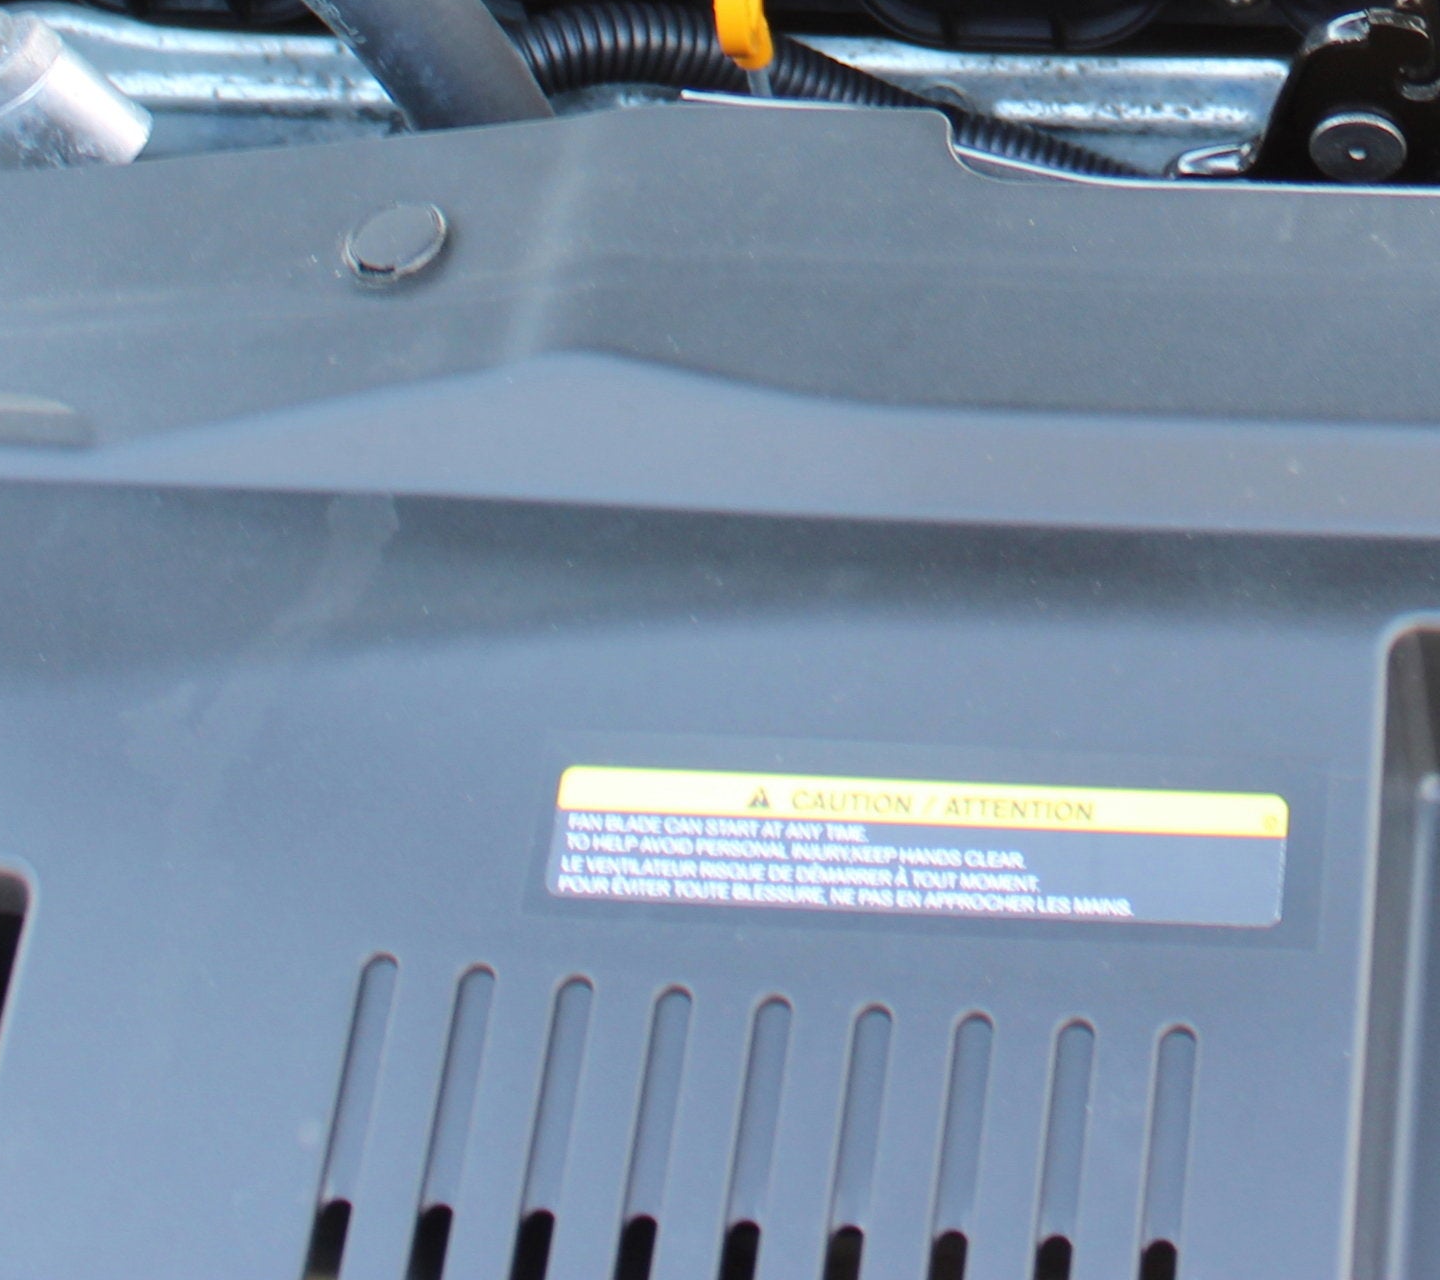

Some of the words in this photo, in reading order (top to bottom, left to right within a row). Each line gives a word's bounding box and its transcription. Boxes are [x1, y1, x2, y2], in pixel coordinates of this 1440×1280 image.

[791, 790, 912, 813] CAUTION
[945, 797, 1095, 822] ATTENTION
[568, 812, 604, 831] FAN
[606, 814, 663, 834] BLADE
[664, 816, 703, 836] CAN
[704, 818, 759, 838] START
[760, 821, 783, 838] AT
[785, 822, 824, 841] ANY
[566, 832, 590, 851] TO
[592, 834, 639, 853] HELP
[640, 836, 694, 856] AVOID
[696, 838, 787, 860] PERSONAL
[900, 846, 962, 867] HANDS
[561, 854, 585, 873] LE
[586, 856, 698, 878] VENTILATEUR
[767, 863, 793, 882] DE
[912, 870, 958, 890] TOUT
[558, 874, 609, 895] POUR
[674, 878, 731, 900] TOUTE
[829, 886, 856, 905] NE
[858, 887, 894, 907] PAS
[896, 890, 922, 908] EN
[923, 891, 1035, 914] APPROCHER
[1037, 895, 1071, 914] LES
